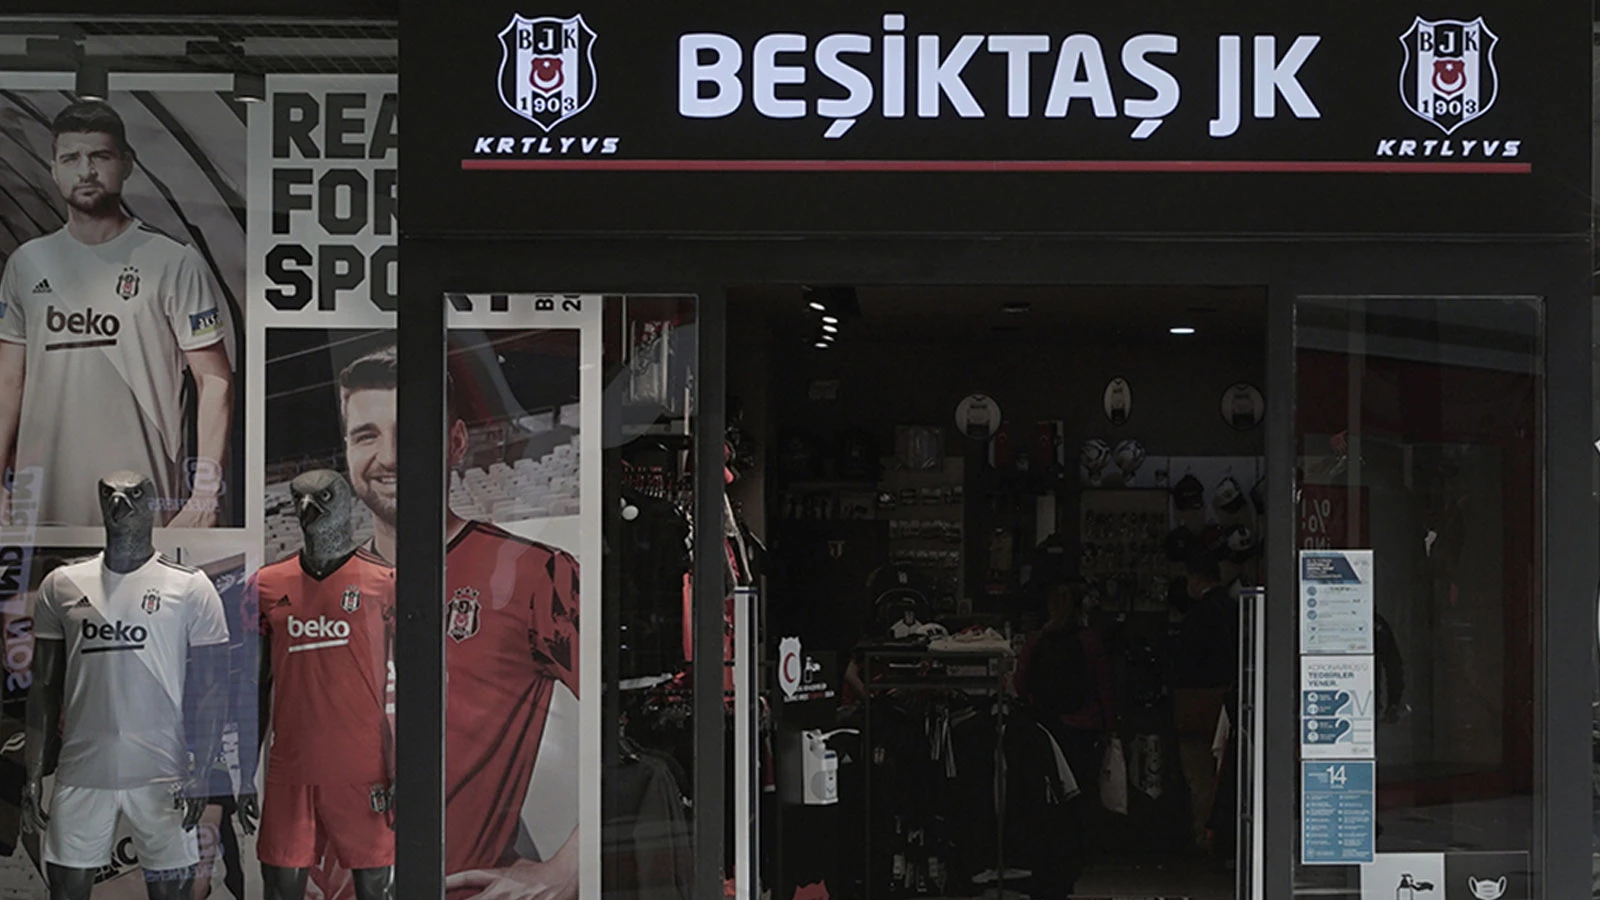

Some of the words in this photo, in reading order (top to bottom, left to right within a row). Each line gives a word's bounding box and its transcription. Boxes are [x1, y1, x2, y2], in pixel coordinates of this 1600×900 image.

[518, 28, 577, 51] BJK
[1419, 31, 1478, 53] BJK
[679, 14, 1181, 139] BEŞİKTAŞ
[1209, 34, 1322, 138] JK
[520, 96, 577, 113] 1903
[1421, 100, 1477, 115] 1903
[474, 137, 620, 154] KRTLYVS
[1376, 139, 1521, 156] KRTLYVS
[46, 305, 120, 337] beko
[81, 619, 148, 643] beko
[287, 615, 351, 639] beko
[1326, 765, 1347, 785] 14
